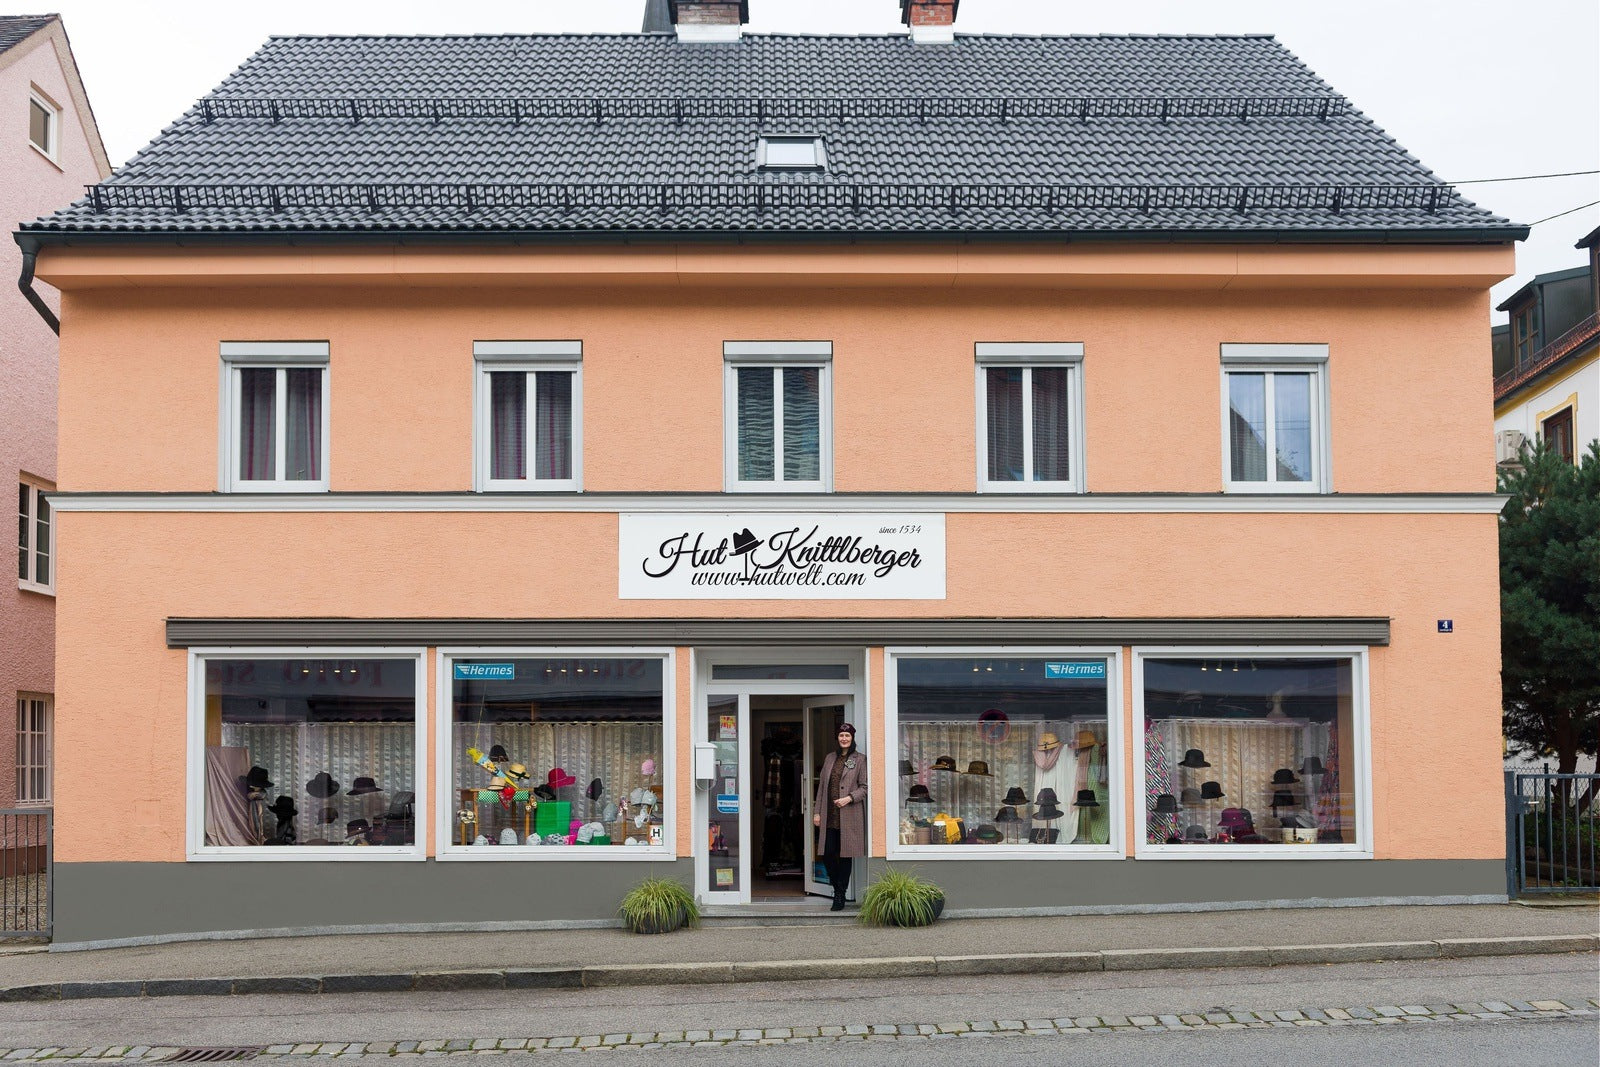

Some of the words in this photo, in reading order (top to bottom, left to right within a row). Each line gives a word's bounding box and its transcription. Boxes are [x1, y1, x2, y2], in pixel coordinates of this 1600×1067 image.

[878, 526, 897, 534] since
[899, 525, 922, 534] 1534
[642, 531, 729, 578] Hut
[750, 525, 922, 578] Knittlberger
[691, 563, 867, 586] www.hutwelt.com
[1442, 620, 1449, 629] 4
[470, 665, 513, 675] Hermes
[1060, 664, 1104, 674] Hermes
